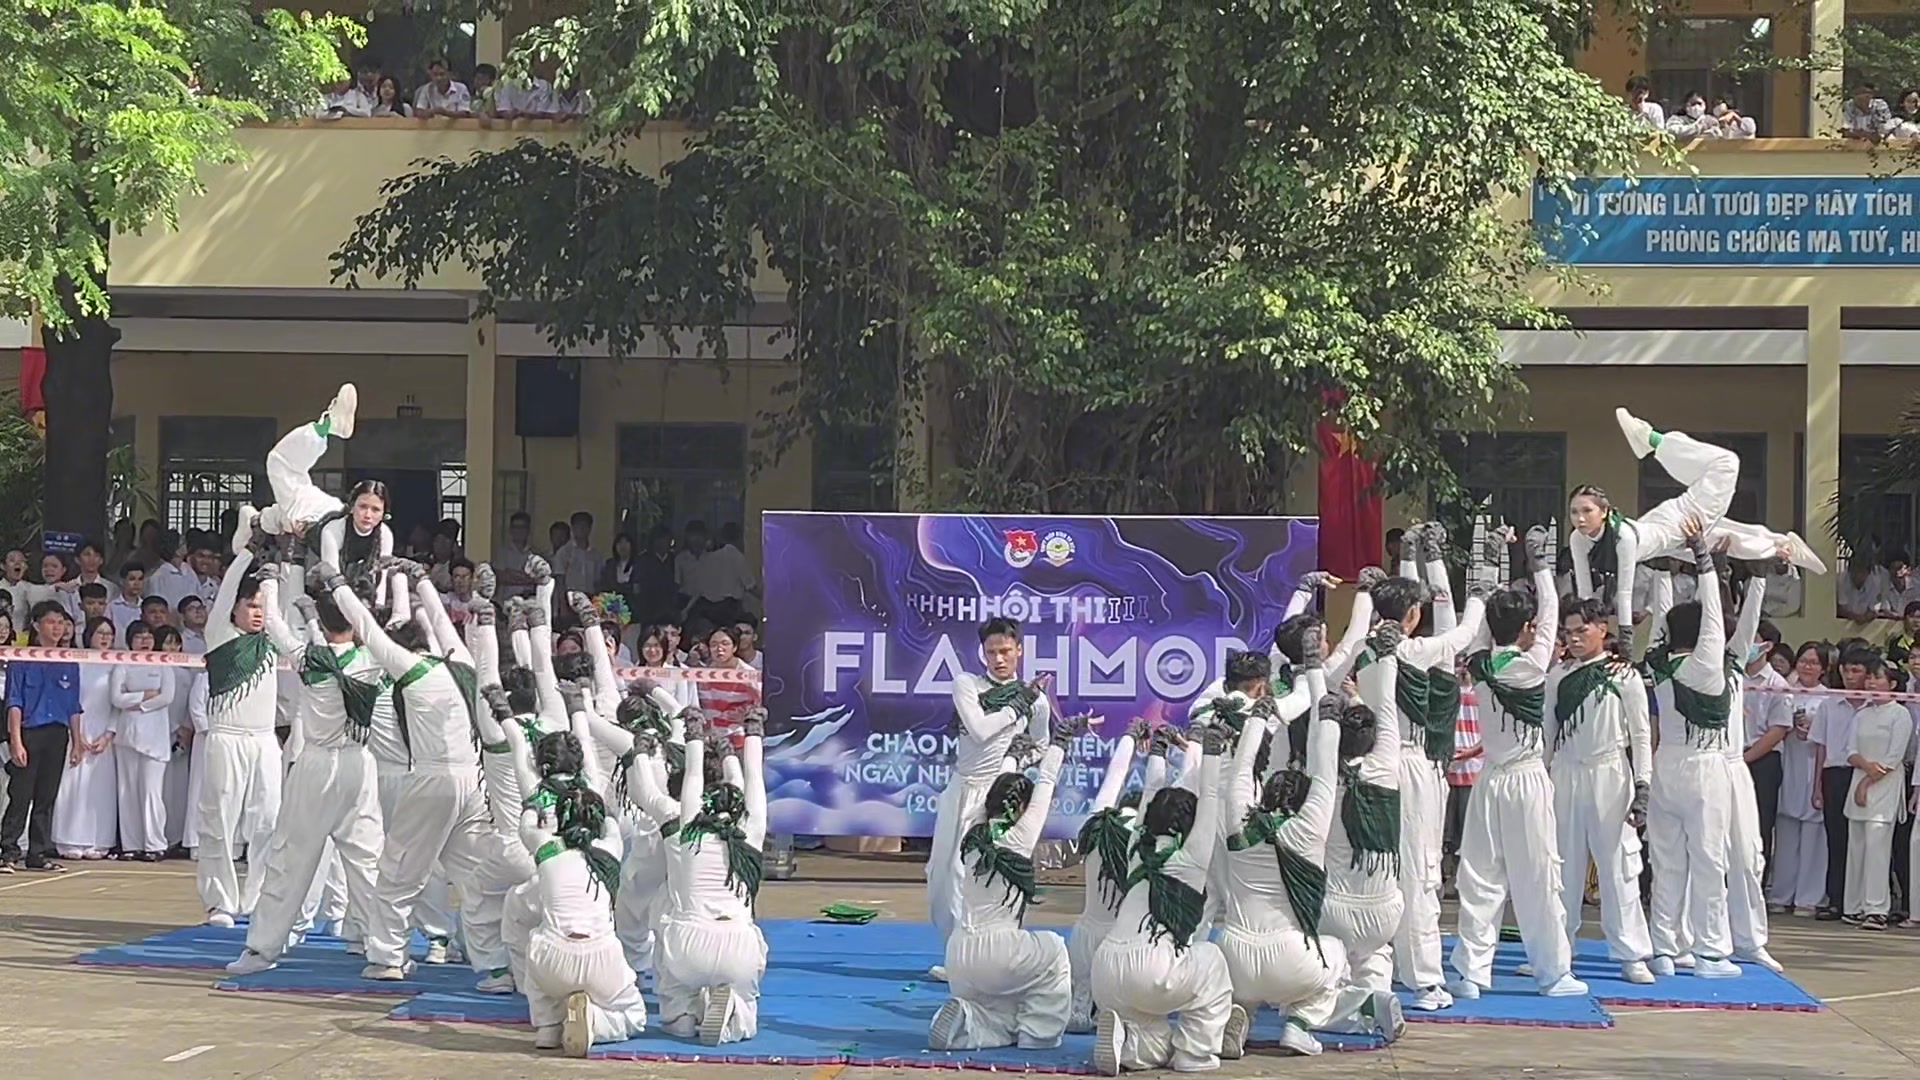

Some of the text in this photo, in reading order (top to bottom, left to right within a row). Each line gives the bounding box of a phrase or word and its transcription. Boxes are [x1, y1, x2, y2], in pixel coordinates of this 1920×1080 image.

[1673, 193, 1706, 216] LAI
[1712, 191, 1760, 216] TƯƠI
[1766, 193, 1809, 221] ĐẸP
[1815, 189, 1858, 216] HÃY
[1864, 188, 1912, 216] TÍCH
[1646, 224, 1720, 252] PHÒNG
[1727, 222, 1800, 253] CHỐNG
[1807, 230, 1842, 253] MA
[1849, 225, 1894, 256] TUÝ,
[823, 631, 1249, 699] FLAHMO
[866, 729, 938, 755] CHÀO
[1068, 733, 1116, 761] IỆM
[845, 760, 913, 784] NGÀY
